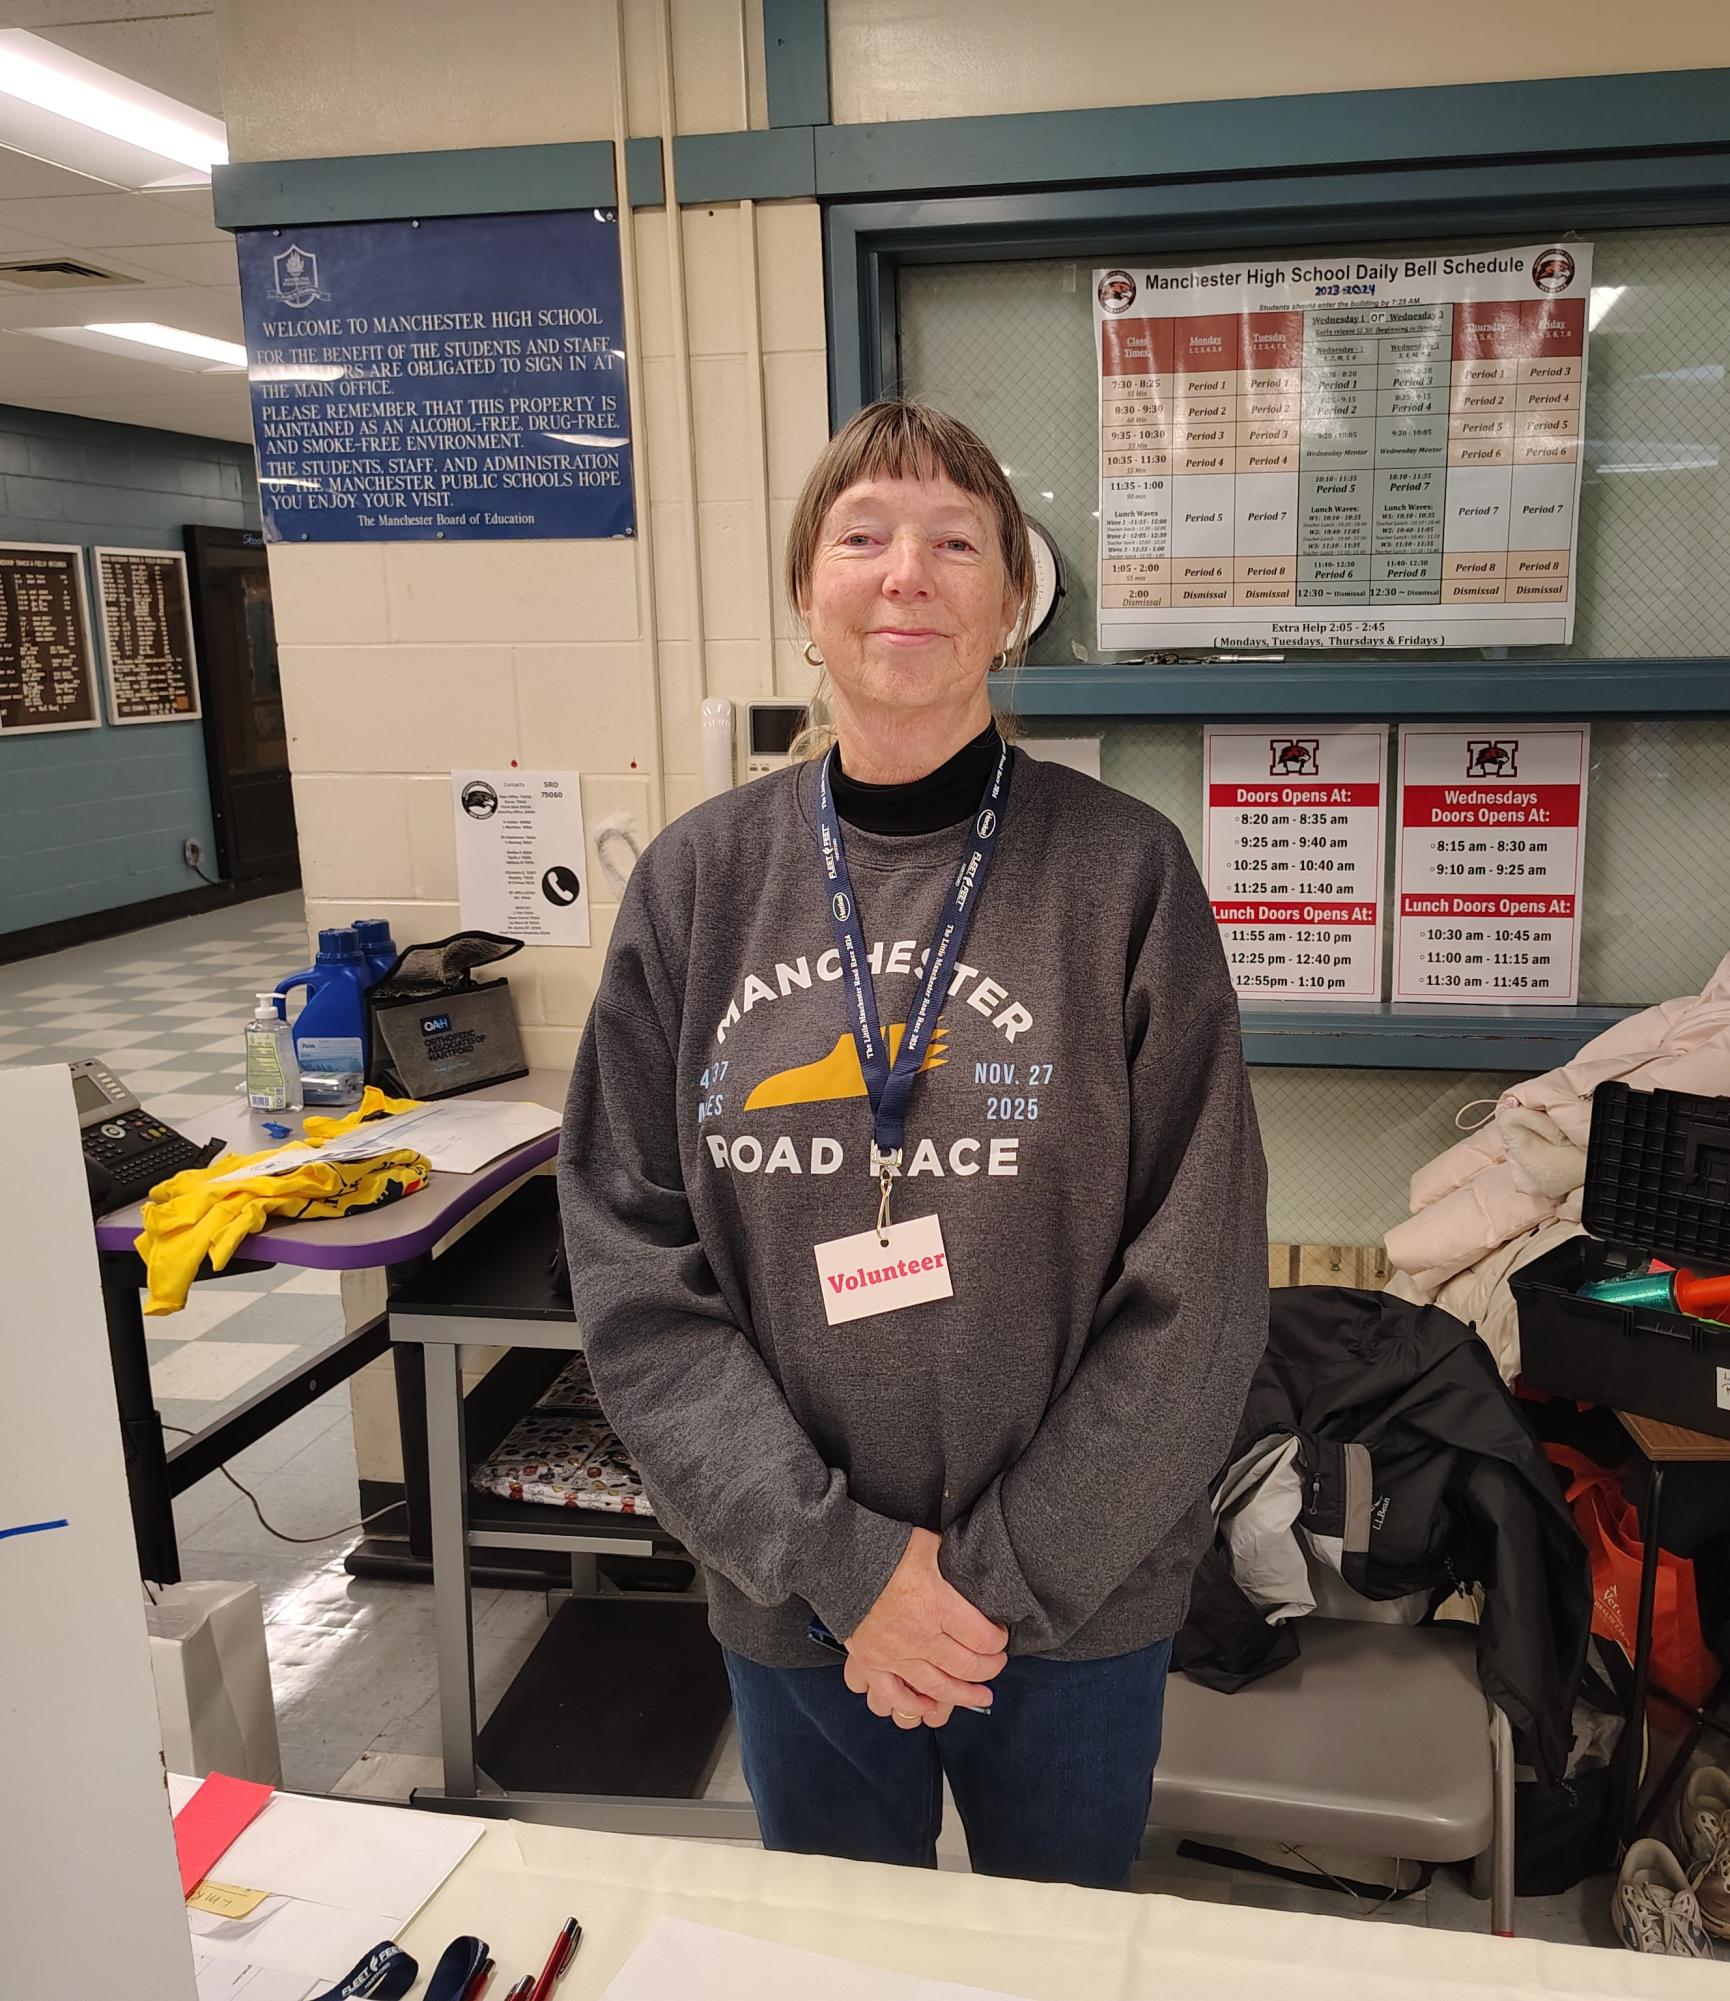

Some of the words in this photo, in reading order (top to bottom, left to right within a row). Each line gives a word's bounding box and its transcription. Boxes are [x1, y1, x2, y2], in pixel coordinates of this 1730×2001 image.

[1146, 272, 1241, 289] Manchester
[1248, 268, 1284, 287] High
[1292, 265, 1350, 282] School
[1357, 264, 1398, 282] Daily
[1405, 260, 1436, 277] Bell
[1444, 257, 1524, 274] Schedule
[263, 319, 342, 337] WELCOME
[347, 318, 367, 334] TO
[373, 313, 486, 333] MANCHESTER
[492, 311, 532, 328] HIGH
[538, 308, 603, 326] SCHOOL
[1312, 315, 1358, 326] Wednesday
[1371, 314, 1384, 322] or
[1190, 336, 1221, 346] Monday
[1254, 334, 1287, 343] Tuesday
[257, 350, 284, 363] FOR
[290, 348, 317, 362] THE
[323, 346, 383, 362] BENEFIT
[388, 344, 406, 359] OF
[410, 343, 440, 358] THE
[445, 340, 521, 357] STUDENTS
[526, 339, 559, 354] AND
[368, 362, 402, 377] ARE
[408, 358, 495, 376] OBLIGATED
[500, 358, 520, 372] TO
[526, 356, 562, 372] SIGN
[570, 356, 586, 370] IN
[594, 354, 615, 369] AT
[259, 383, 290, 398] THE
[293, 380, 335, 397] MAIN
[262, 405, 320, 421] PLEASE
[327, 402, 418, 418] REMEMBER
[423, 400, 463, 415] THAT
[468, 399, 504, 414] THIS
[510, 396, 594, 413] PROPERTY
[602, 396, 616, 410] IS
[264, 420, 354, 437] MAINTAINED
[360, 420, 378, 434] AS
[382, 419, 403, 434] AN
[266, 440, 298, 454] AND
[302, 436, 401, 453] SMOKE-FREE
[267, 462, 298, 476] THE
[444, 457, 477, 472] AND
[484, 454, 618, 471] ADMINISTRATION
[327, 475, 436, 494] MANCHESTER
[441, 474, 497, 489] PUBLIC
[503, 472, 572, 488] SCHOOLS
[579, 471, 620, 486] HOPE
[271, 495, 301, 510] YOU
[308, 492, 357, 508] ENJOY
[363, 493, 406, 507] YOUR
[358, 515, 375, 526] The
[379, 514, 433, 526] Manchester
[437, 514, 466, 525] Board
[469, 513, 480, 524] of
[485, 513, 534, 524] Education
[1517, 585, 1562, 594] Dismissal
[1272, 624, 1299, 632] Extra
[1303, 623, 1326, 634] Help
[1330, 623, 1352, 632] 2:05
[1362, 623, 1384, 631] 2:45
[1220, 637, 1270, 648] Mondays,
[1272, 637, 1324, 648] Tuesdays,
[1329, 636, 1384, 646] Thursdays
[1399, 636, 1437, 646] Fridays
[1238, 789, 1278, 802] Doors
[1282, 789, 1327, 805] Opens
[1330, 788, 1351, 802] At:
[1445, 790, 1537, 807] Wednesdays
[1242, 814, 1268, 824] 8:20
[1300, 814, 1326, 824] 8:35
[1432, 809, 1474, 822] Doors
[1478, 808, 1524, 825] Opens
[1528, 808, 1549, 822] At:
[1438, 841, 1464, 851] 8:15
[1498, 841, 1525, 851] 8:30
[966, 852, 982, 878] FLEET
[1212, 906, 1254, 919] Lunch
[1259, 906, 1300, 920] Doors
[1304, 907, 1348, 922] Opens
[1352, 908, 1372, 920] At:
[1406, 899, 1448, 912] Lunch
[1454, 899, 1495, 912] Doors
[1500, 899, 1546, 916] Opens
[1549, 900, 1570, 914] At:
[944, 924, 954, 937] The
[937, 937, 950, 958] Little
[926, 957, 944, 998] Manchester
[1237, 975, 1287, 988] 12:55pm
[1299, 976, 1324, 987] 1:10
[1328, 980, 1345, 989] pm
[717, 940, 1034, 1044] MANCHESTER
[919, 997, 931, 1016] Road
[424, 1018, 448, 1031] OAH
[913, 1015, 924, 1033] Race
[908, 1033, 919, 1051] 2024
[974, 1062, 1020, 1085] NOV.
[1029, 1064, 1054, 1085] 27
[987, 1098, 1039, 1120] 2025
[706, 1134, 844, 1175] ROAD
[828, 1253, 944, 1293] Volunteer
[342, 1967, 370, 1996] FLEET
